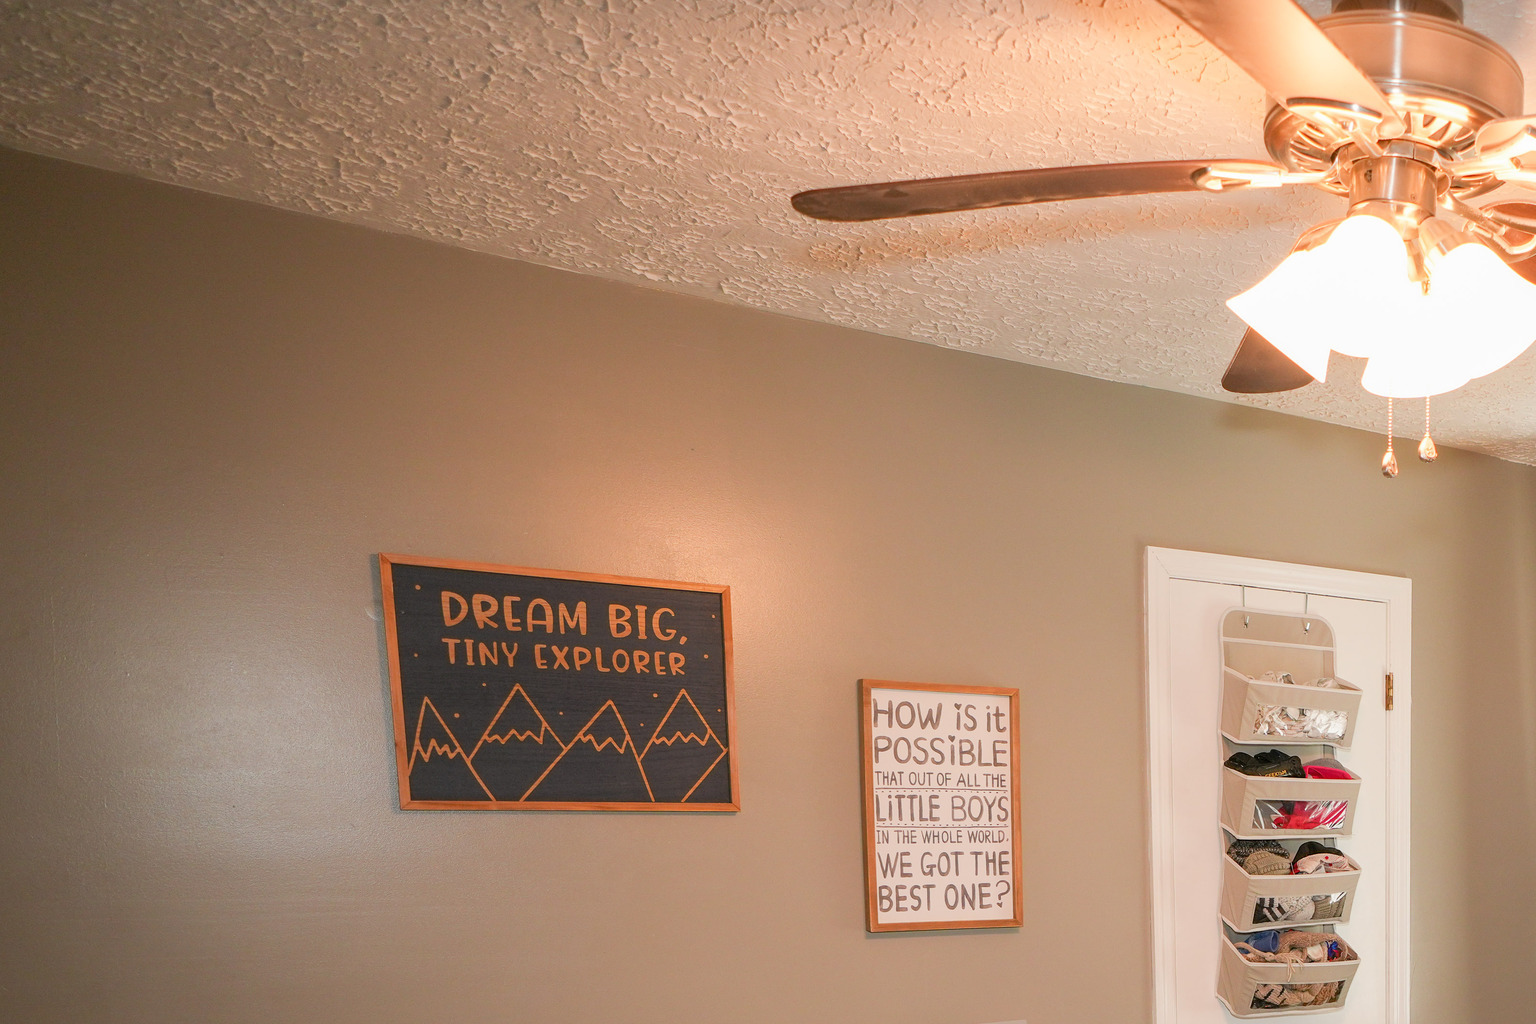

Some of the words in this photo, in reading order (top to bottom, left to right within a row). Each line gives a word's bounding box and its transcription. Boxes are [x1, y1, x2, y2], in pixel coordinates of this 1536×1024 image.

[440, 590, 588, 636] DREAM
[608, 603, 688, 645] BIG,
[441, 637, 519, 668] TINY
[534, 643, 686, 676] EXPLORER
[873, 698, 943, 730] HOW
[875, 771, 904, 786] THAT
[908, 771, 934, 786] OUT
[937, 773, 951, 786] OF
[956, 773, 981, 788] ALL
[983, 773, 1007, 788] THE
[951, 795, 1009, 822] BOYS
[876, 830, 889, 844] IN
[894, 830, 917, 844] THE
[921, 830, 963, 844] WHOLE
[878, 851, 913, 878] WE
[921, 851, 964, 877] GOT
[970, 851, 1010, 876] THE
[879, 884, 936, 912] BEST
[944, 879, 1010, 910] ONE?
